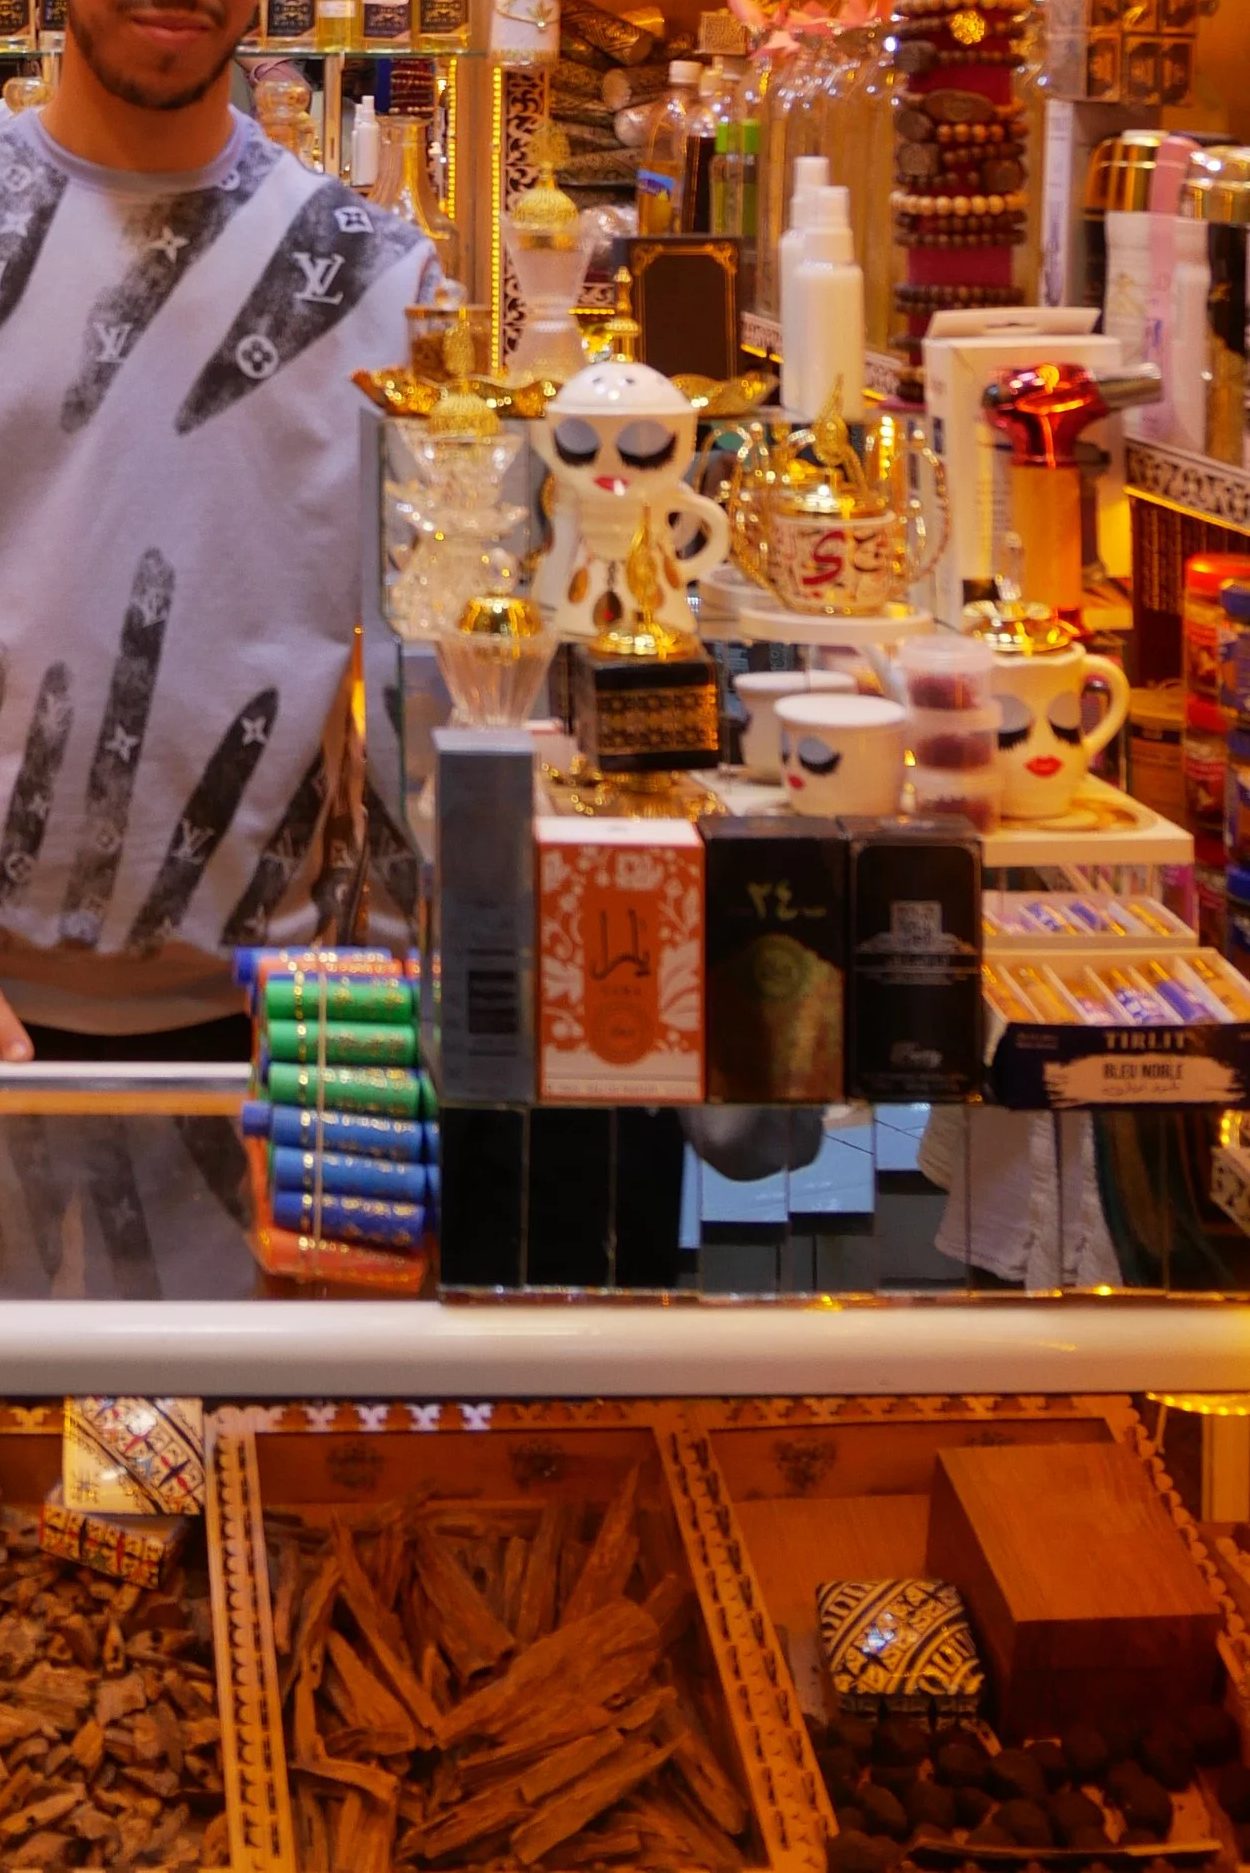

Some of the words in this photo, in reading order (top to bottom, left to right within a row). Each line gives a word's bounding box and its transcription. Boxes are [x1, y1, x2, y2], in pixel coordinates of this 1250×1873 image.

[292, 250, 344, 305] LV
[92, 320, 134, 365] LV
[802, 531, 846, 586] S
[1105, 1031, 1186, 1049] TIRLIT
